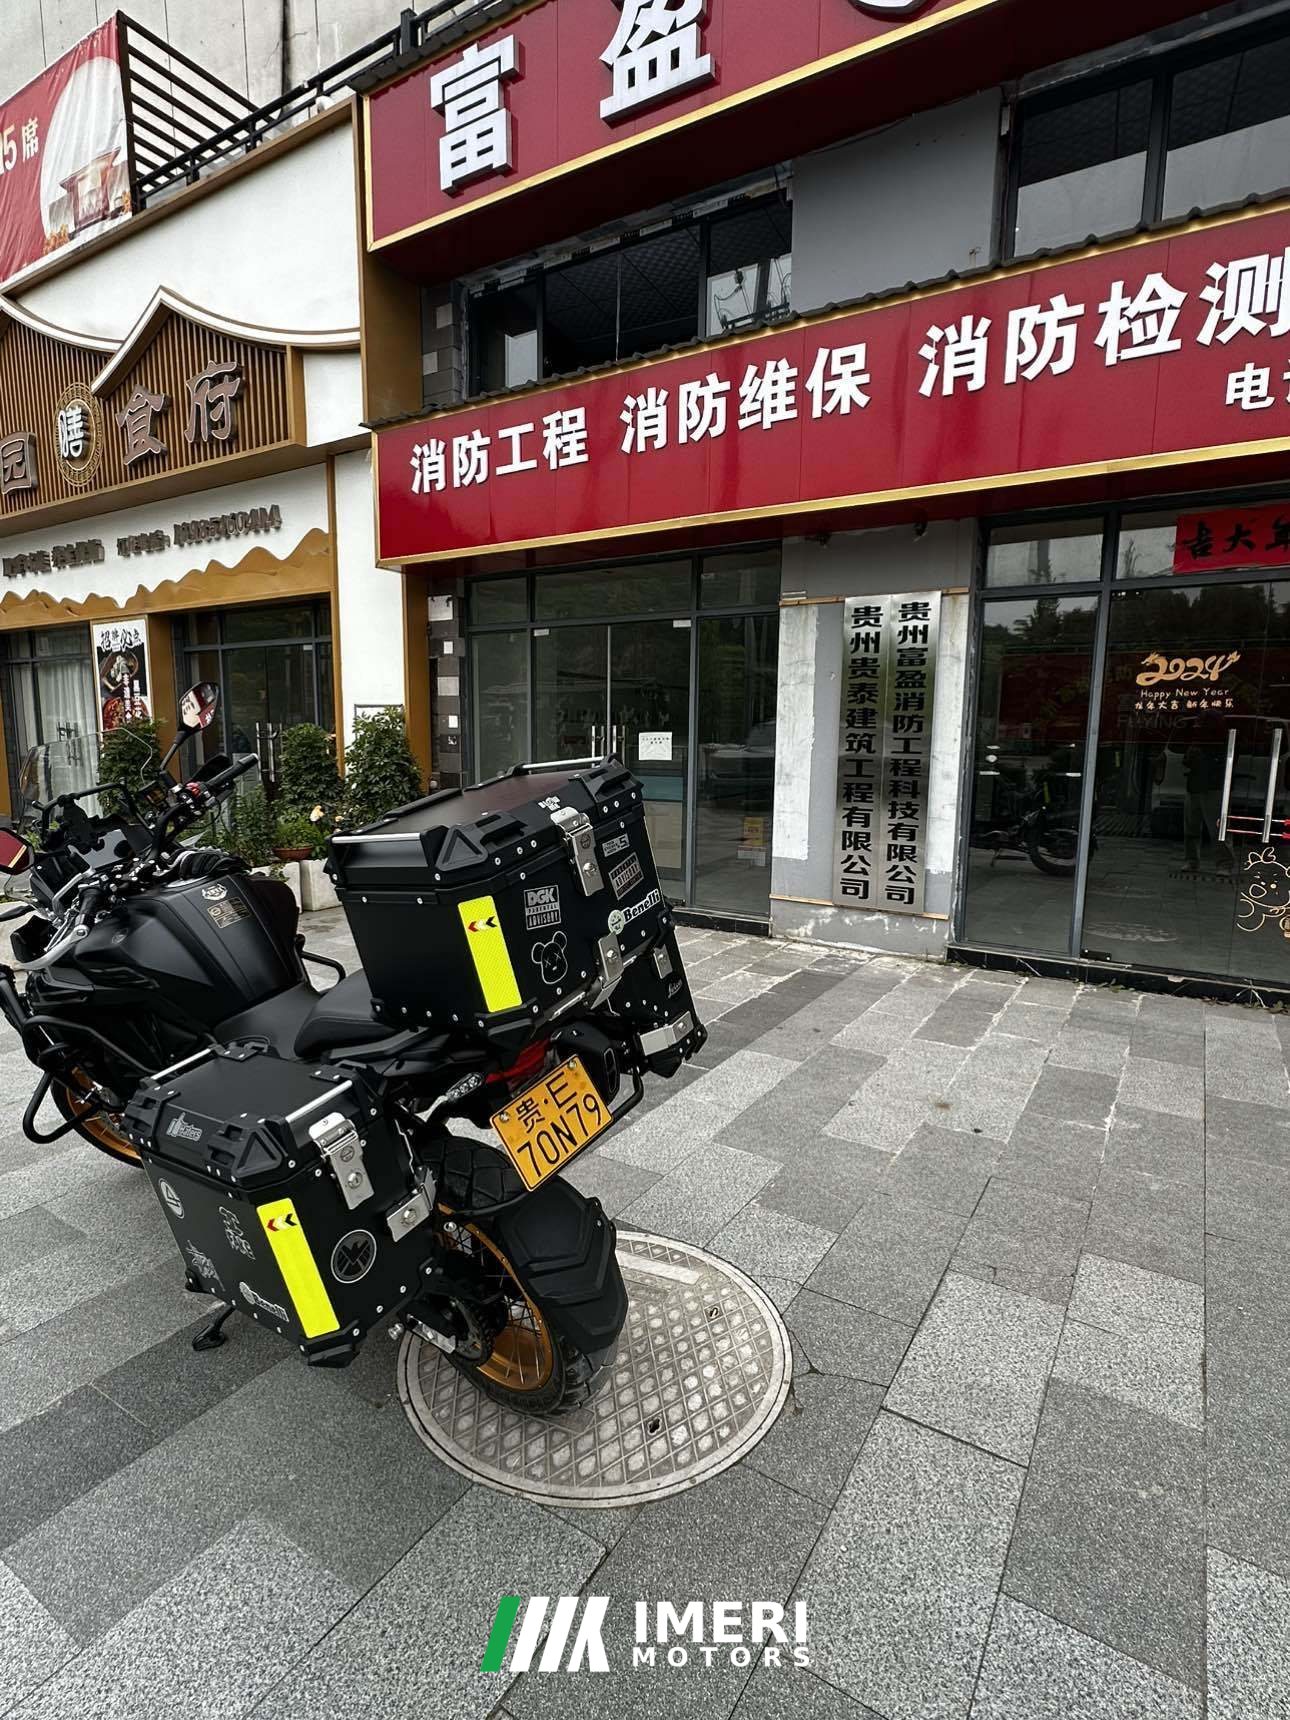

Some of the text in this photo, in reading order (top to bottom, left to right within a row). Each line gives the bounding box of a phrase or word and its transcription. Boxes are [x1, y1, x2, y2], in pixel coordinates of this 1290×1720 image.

[410, 247, 1290, 494] 消防工程 消防维保 消防检测
[1225, 362, 1290, 411] 电
[1136, 651, 1241, 686] 2024
[1141, 687, 1229, 700] Happy New Year
[840, 605, 883, 900] 贵州贵泰建筑工程有限公司
[885, 601, 931, 905] 贵州富盈消防工程科技有限公司
[527, 887, 557, 907] DGK
[623, 889, 661, 923] Benelli
[516, 1093, 602, 1177] 70N79
